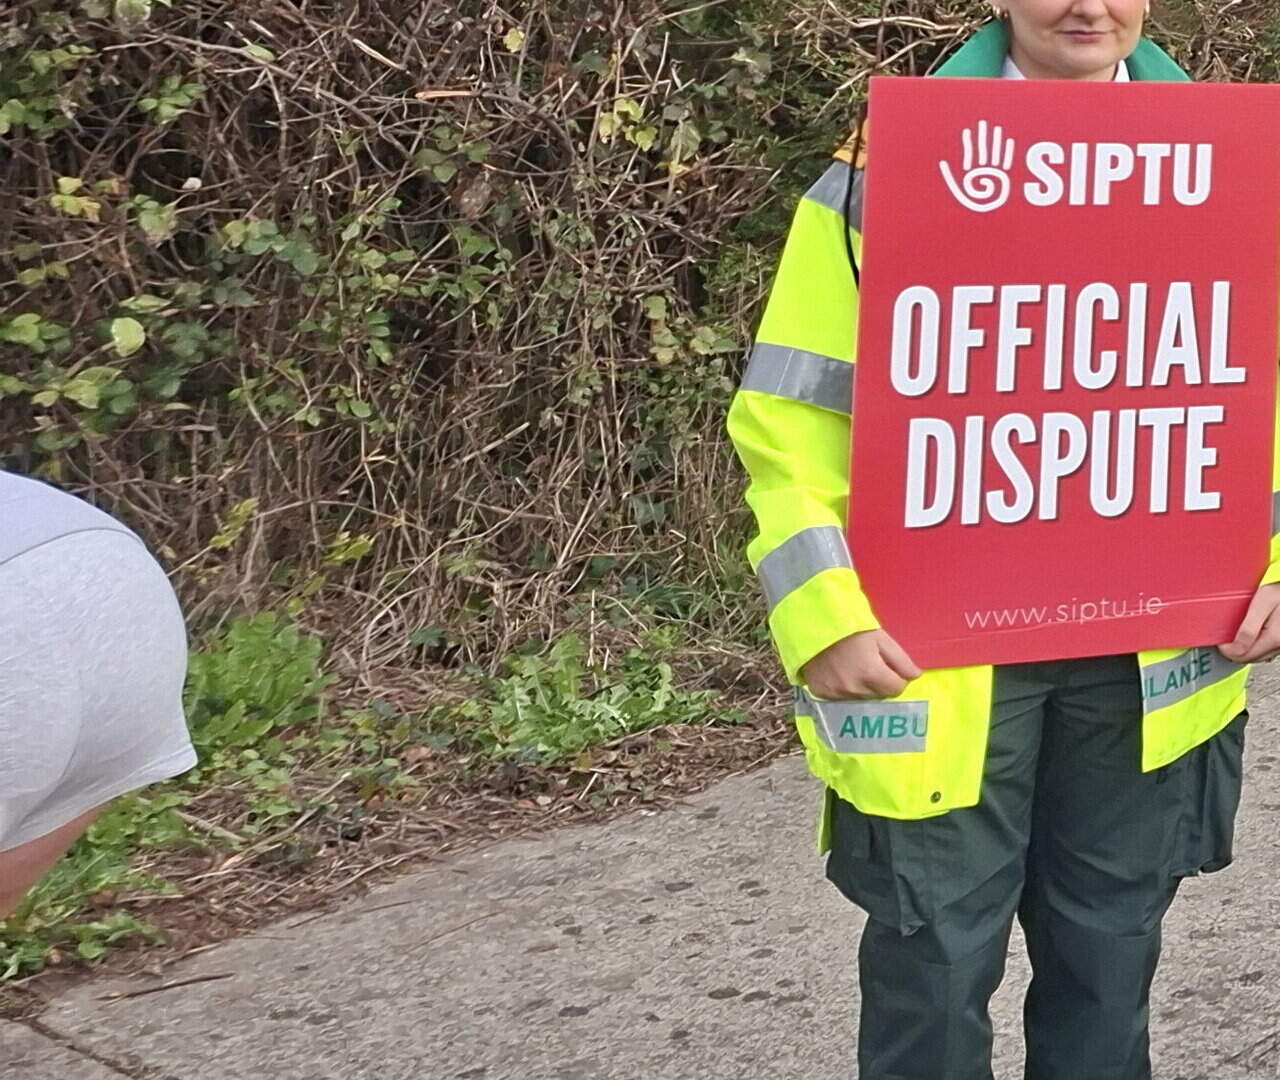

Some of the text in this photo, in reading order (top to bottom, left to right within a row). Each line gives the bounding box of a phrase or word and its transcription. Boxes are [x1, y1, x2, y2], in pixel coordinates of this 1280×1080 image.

[1024, 142, 1212, 207] SIPTU
[889, 281, 1246, 396] OFFICIAL
[905, 405, 1224, 528] DISPUTE
[964, 592, 1163, 629] www.siptu.ie
